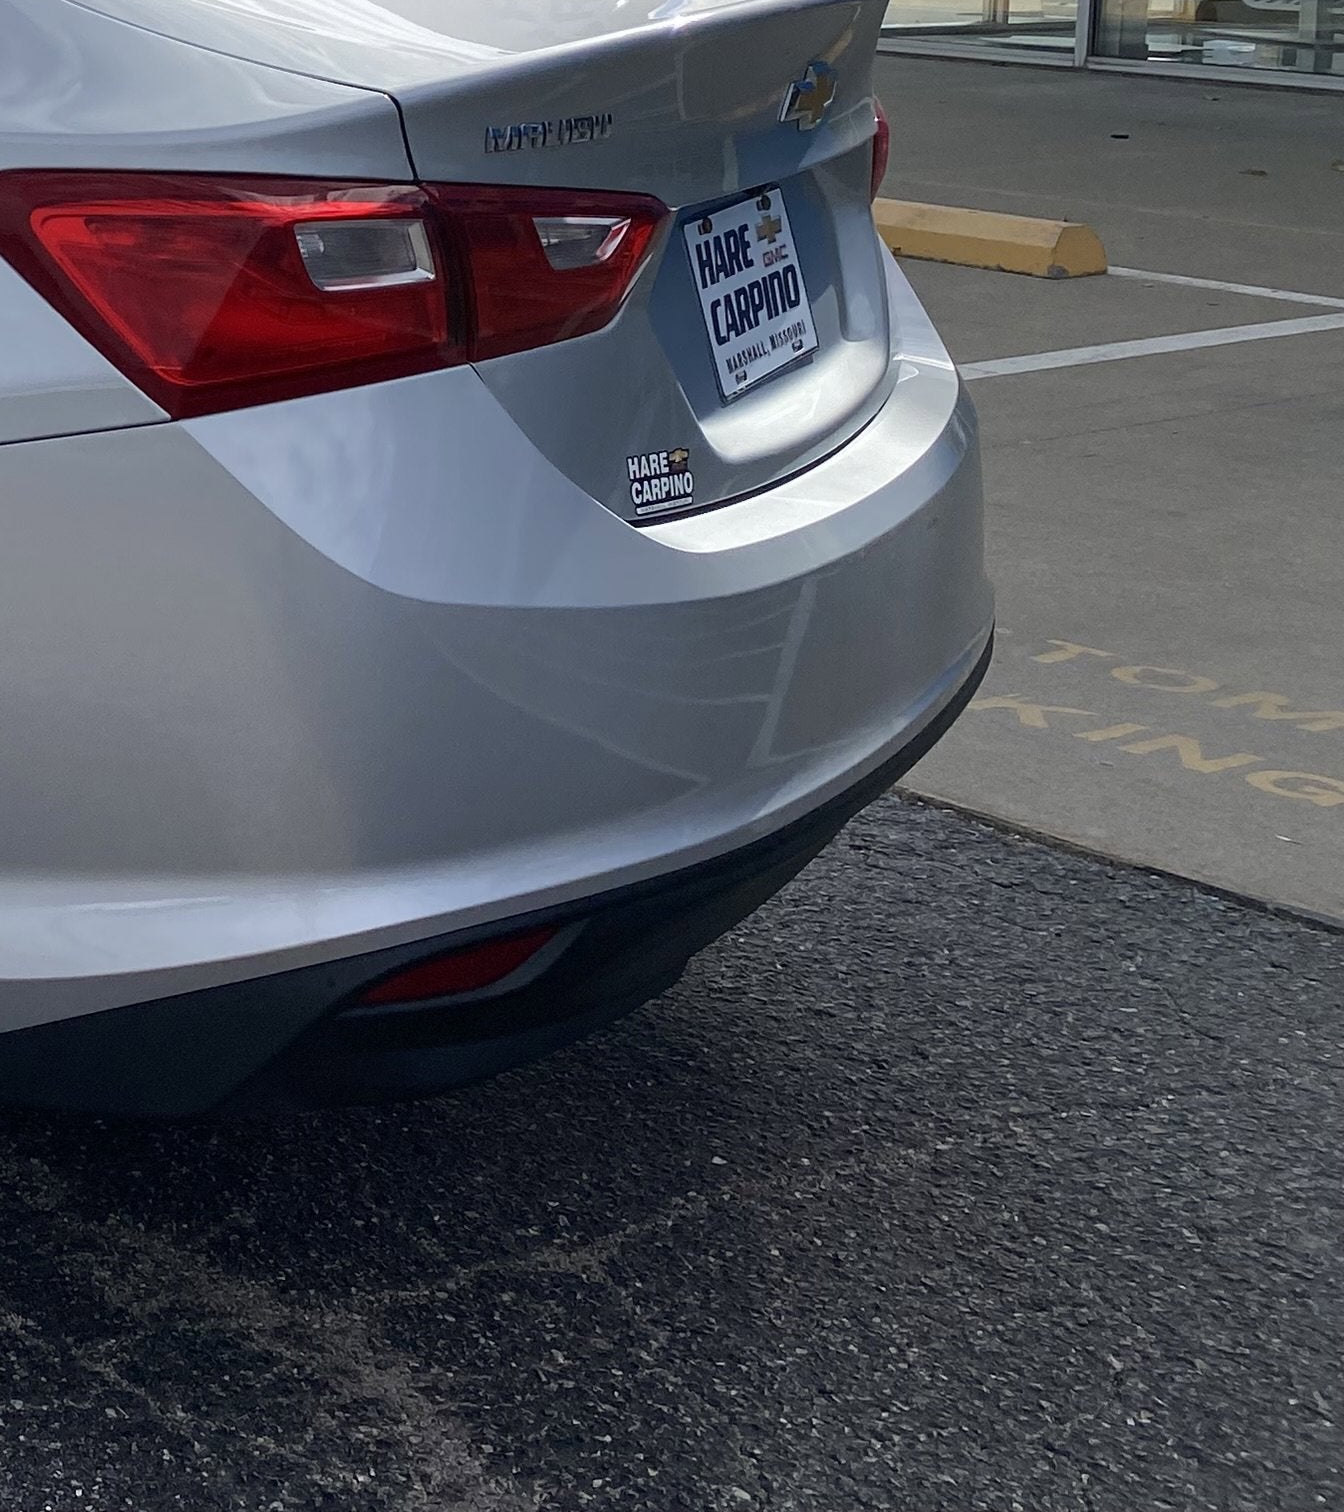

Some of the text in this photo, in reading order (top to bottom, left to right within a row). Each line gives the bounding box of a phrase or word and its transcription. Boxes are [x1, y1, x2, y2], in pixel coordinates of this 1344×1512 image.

[695, 223, 754, 290] HARE
[762, 244, 789, 268] GMC
[710, 263, 801, 346] CARPINO
[770, 319, 807, 349] MISSOURI
[627, 451, 670, 480] HARE
[631, 471, 693, 505] CARPINO
